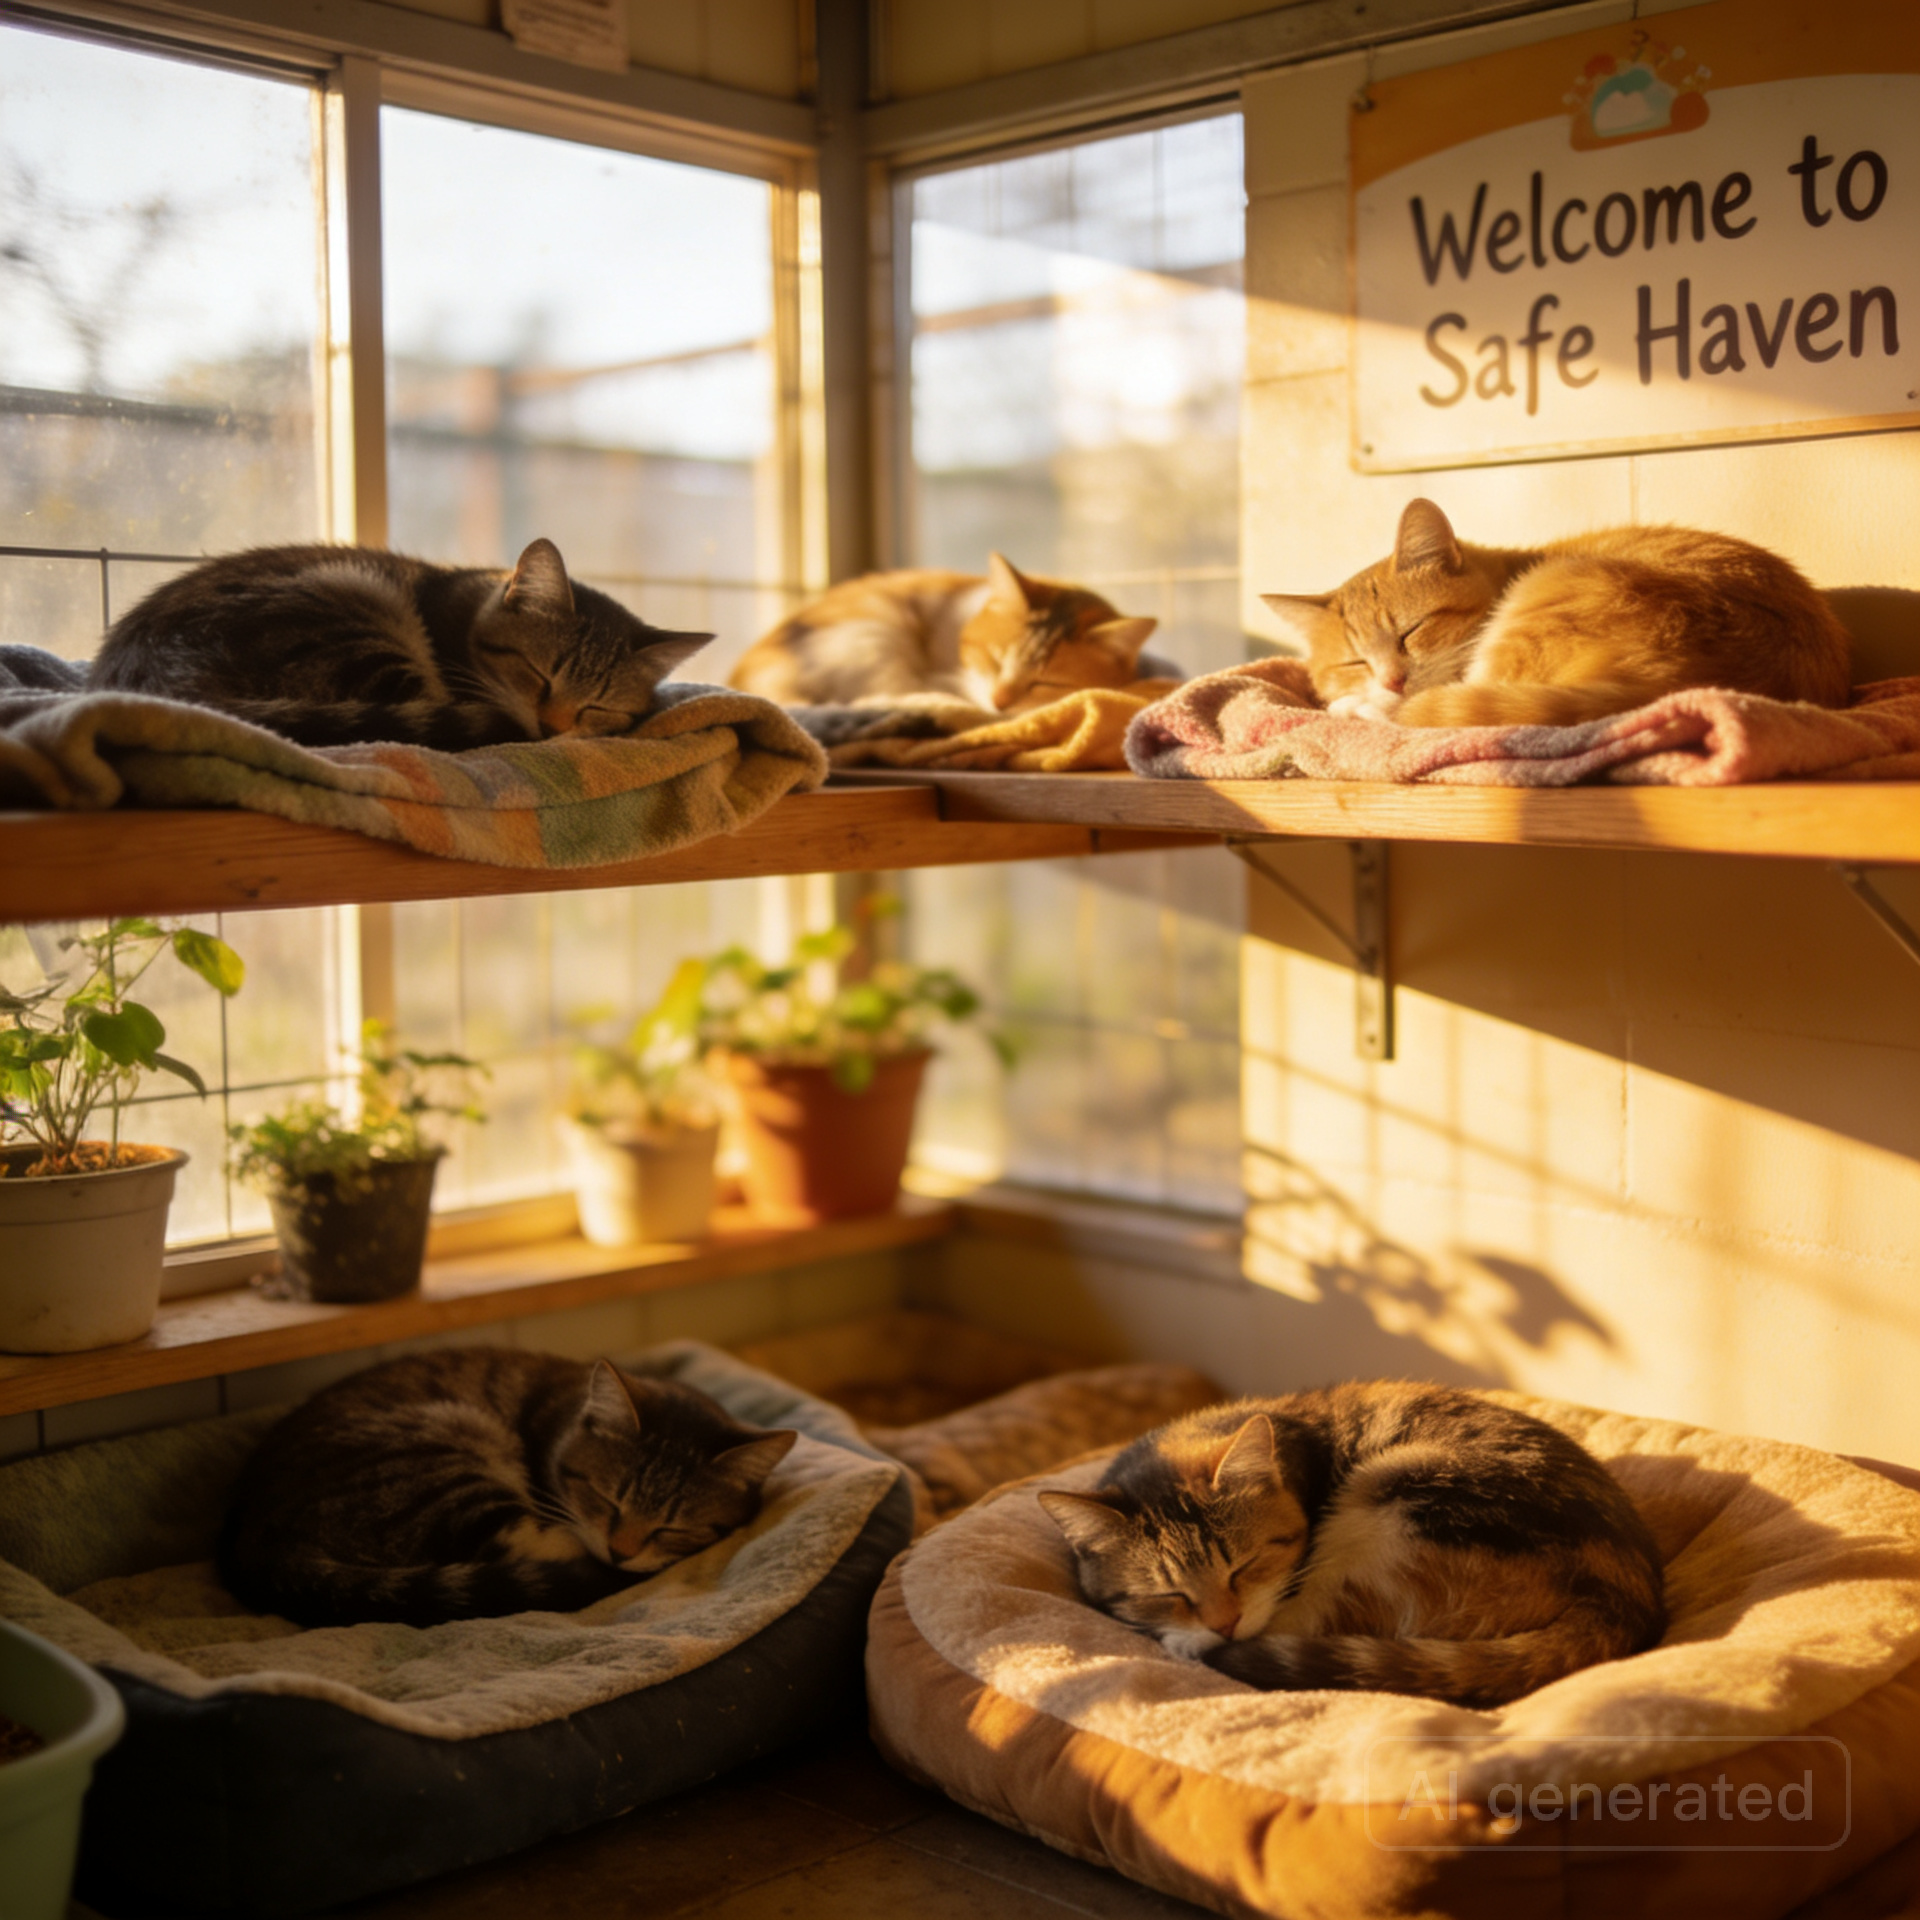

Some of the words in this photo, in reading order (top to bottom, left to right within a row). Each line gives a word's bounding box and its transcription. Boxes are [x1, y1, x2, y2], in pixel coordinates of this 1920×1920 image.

[1409, 170, 1757, 286] Welcome
[1788, 135, 1888, 227] to
[1419, 293, 1600, 416] Safe
[1635, 277, 1899, 386] Haven
